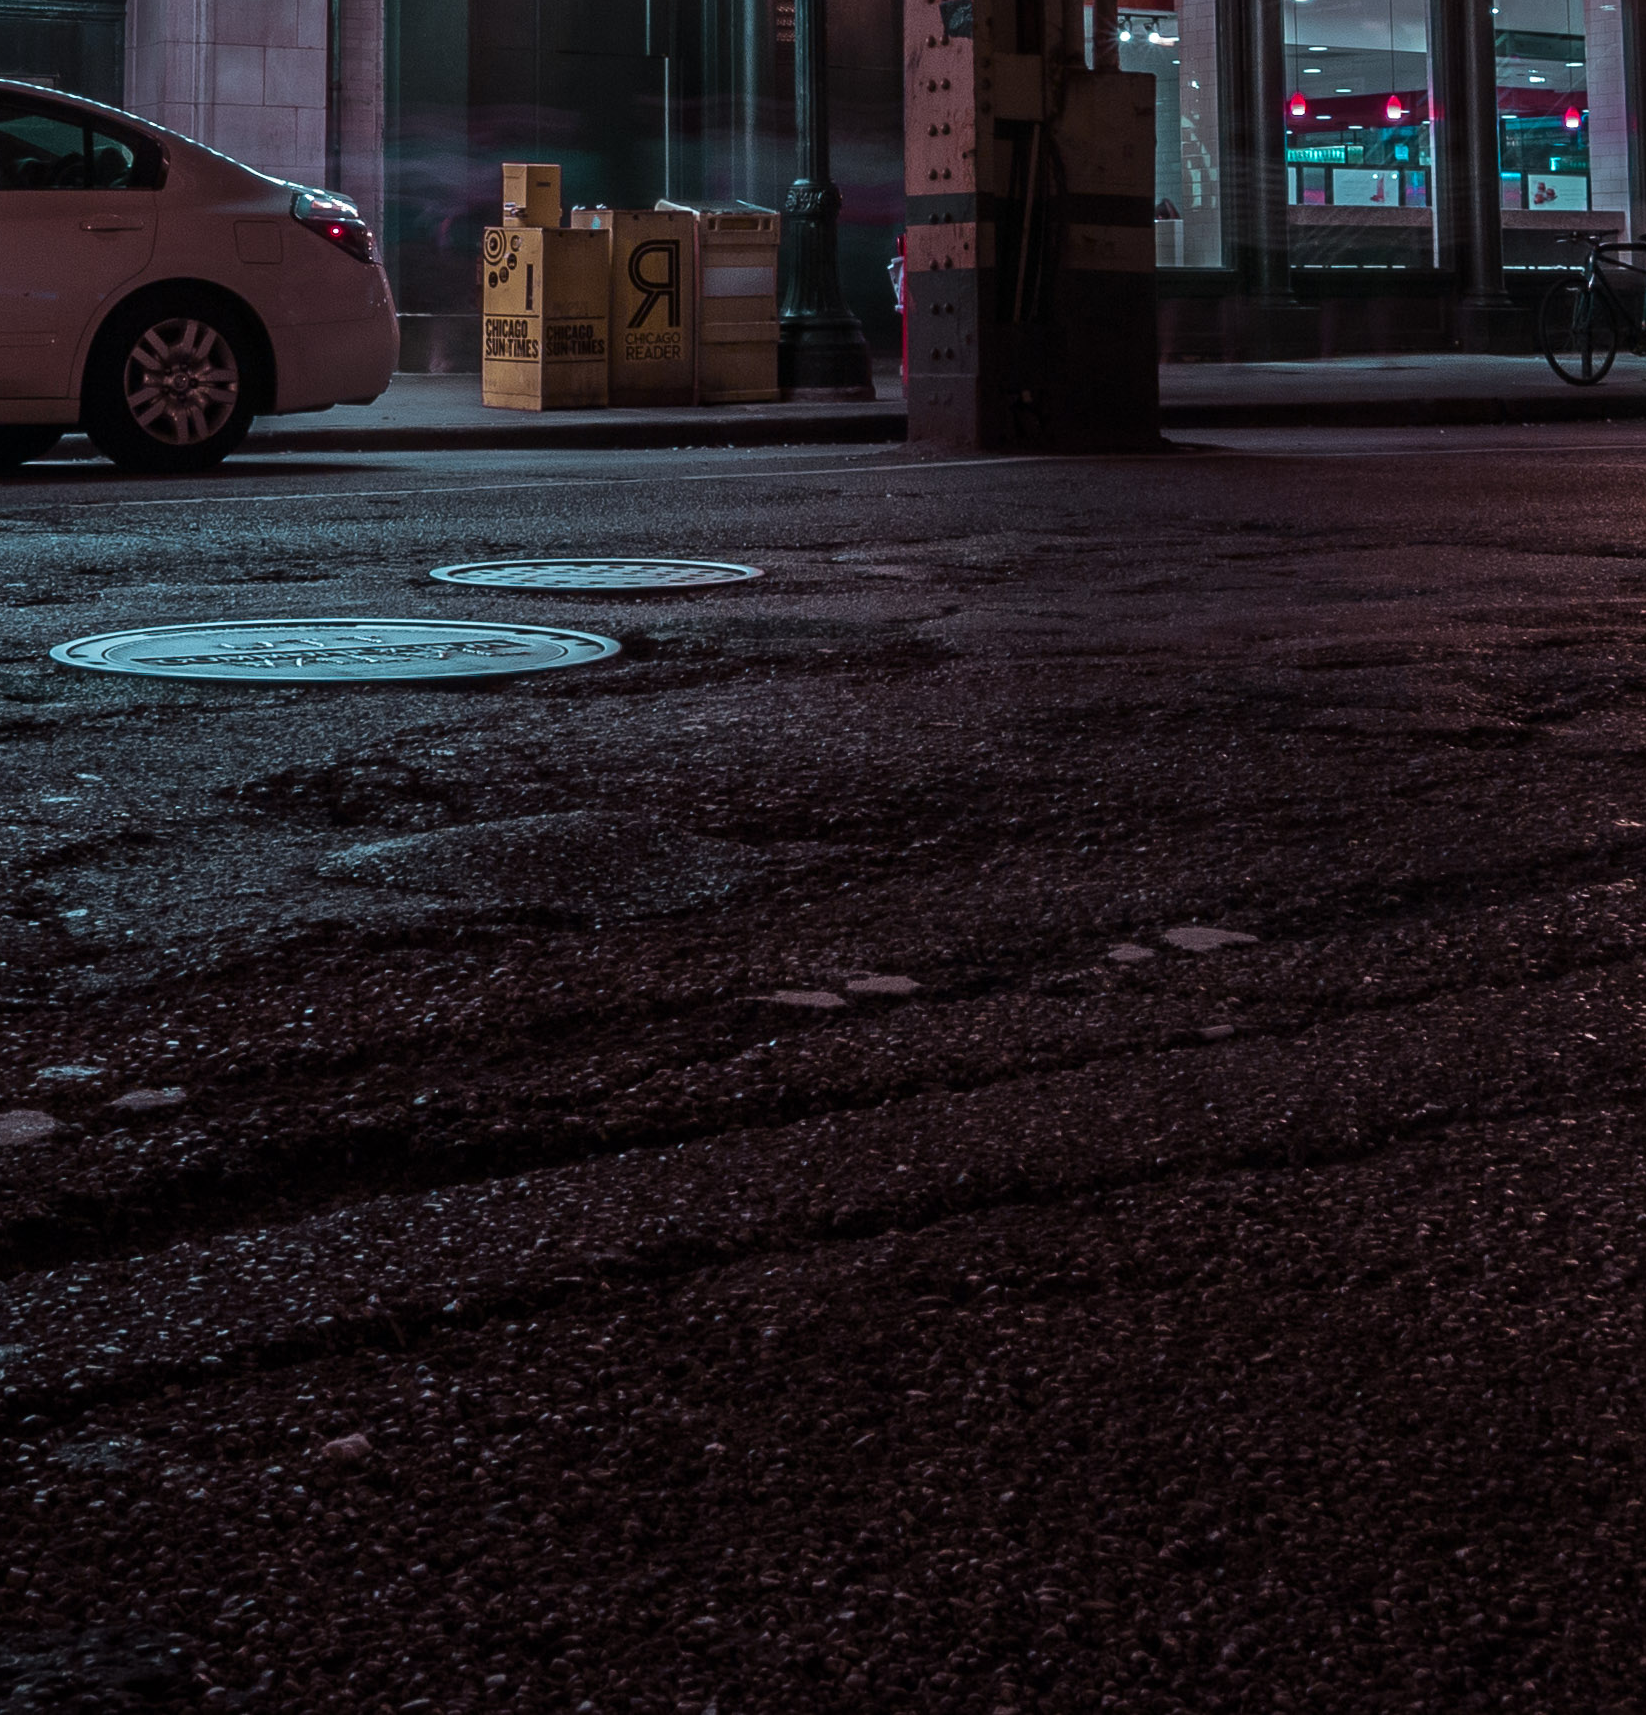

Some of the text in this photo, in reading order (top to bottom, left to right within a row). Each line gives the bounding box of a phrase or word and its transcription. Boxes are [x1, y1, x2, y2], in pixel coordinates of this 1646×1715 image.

[485, 318, 529, 339] CHICAGO
[546, 324, 594, 340] CHICAGO
[625, 331, 682, 346] CHICAGO
[625, 345, 682, 361] READER
